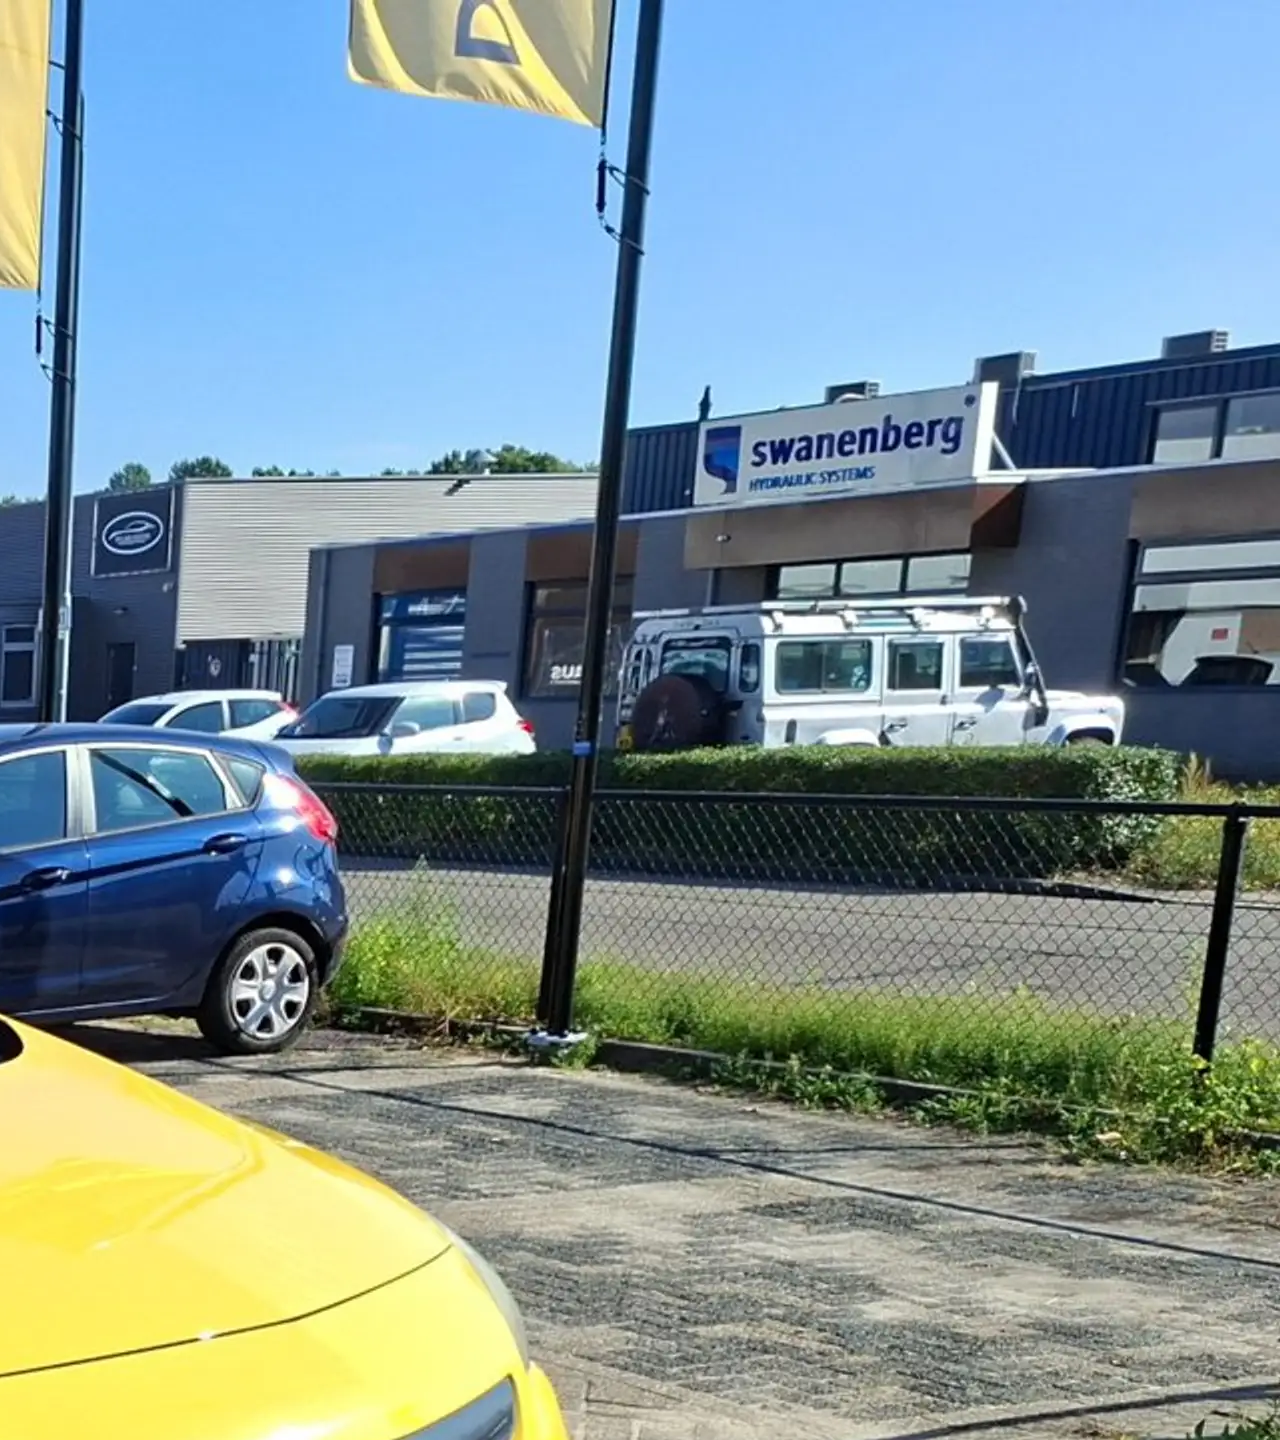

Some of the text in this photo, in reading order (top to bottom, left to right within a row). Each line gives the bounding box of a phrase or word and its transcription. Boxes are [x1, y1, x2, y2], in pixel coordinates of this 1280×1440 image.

[750, 414, 964, 467] swanenberg
[749, 466, 876, 492] HYDRAULIC SYSTEMS
